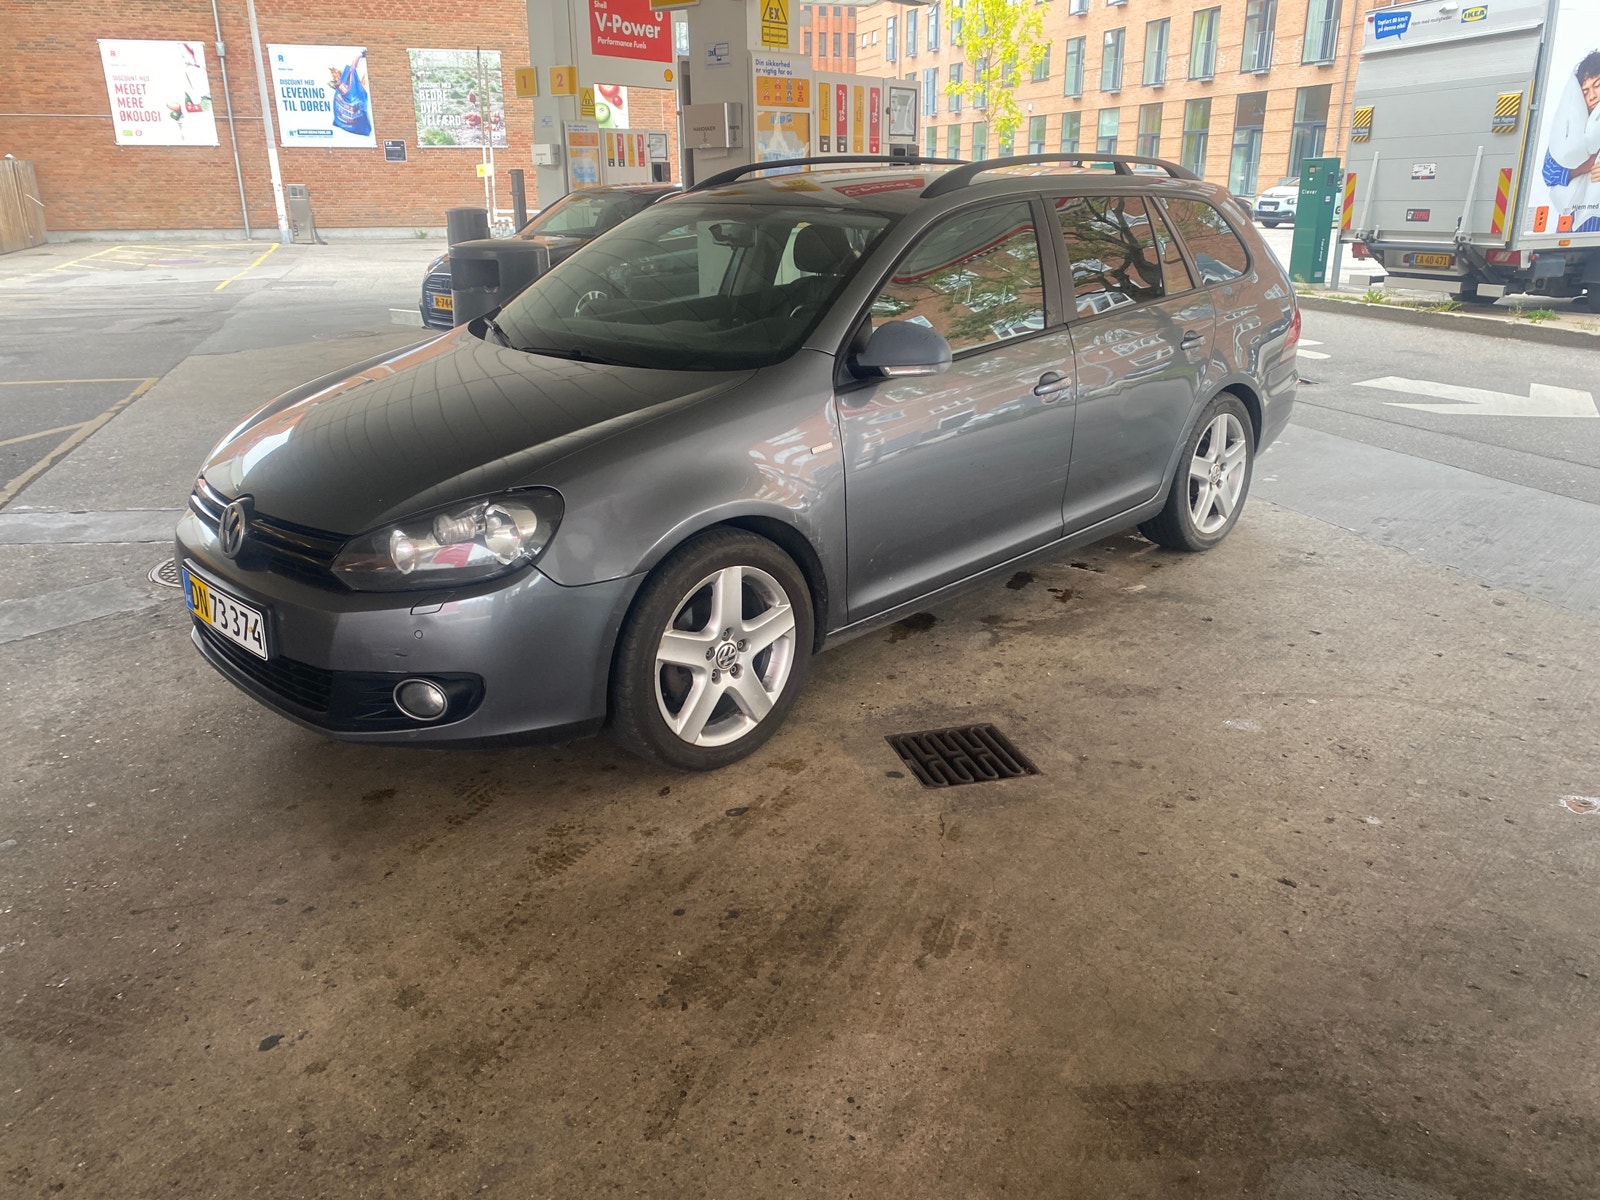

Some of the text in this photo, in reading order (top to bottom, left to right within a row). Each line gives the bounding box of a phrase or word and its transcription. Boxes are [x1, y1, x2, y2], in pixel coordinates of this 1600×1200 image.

[594, 0, 607, 9] Shell
[769, 7, 780, 20] EX
[1464, 10, 1485, 19] IKEA
[594, 12, 660, 38] V-Power
[598, 36, 647, 49] Performance Fuels
[766, 60, 790, 68] sikkerhed
[763, 67, 777, 75] vigtig
[522, 75, 527, 88] 1
[556, 73, 564, 87] 2
[114, 83, 146, 95] MEGET
[281, 87, 325, 99] LEVERING
[420, 90, 448, 100] BEDRE
[117, 97, 144, 108] MERE
[283, 100, 297, 111] TIL
[300, 100, 331, 112] DØREN
[119, 110, 161, 122] ØKOLOGI
[421, 114, 461, 127] VELFÆRD
[1415, 255, 1424, 264] EA
